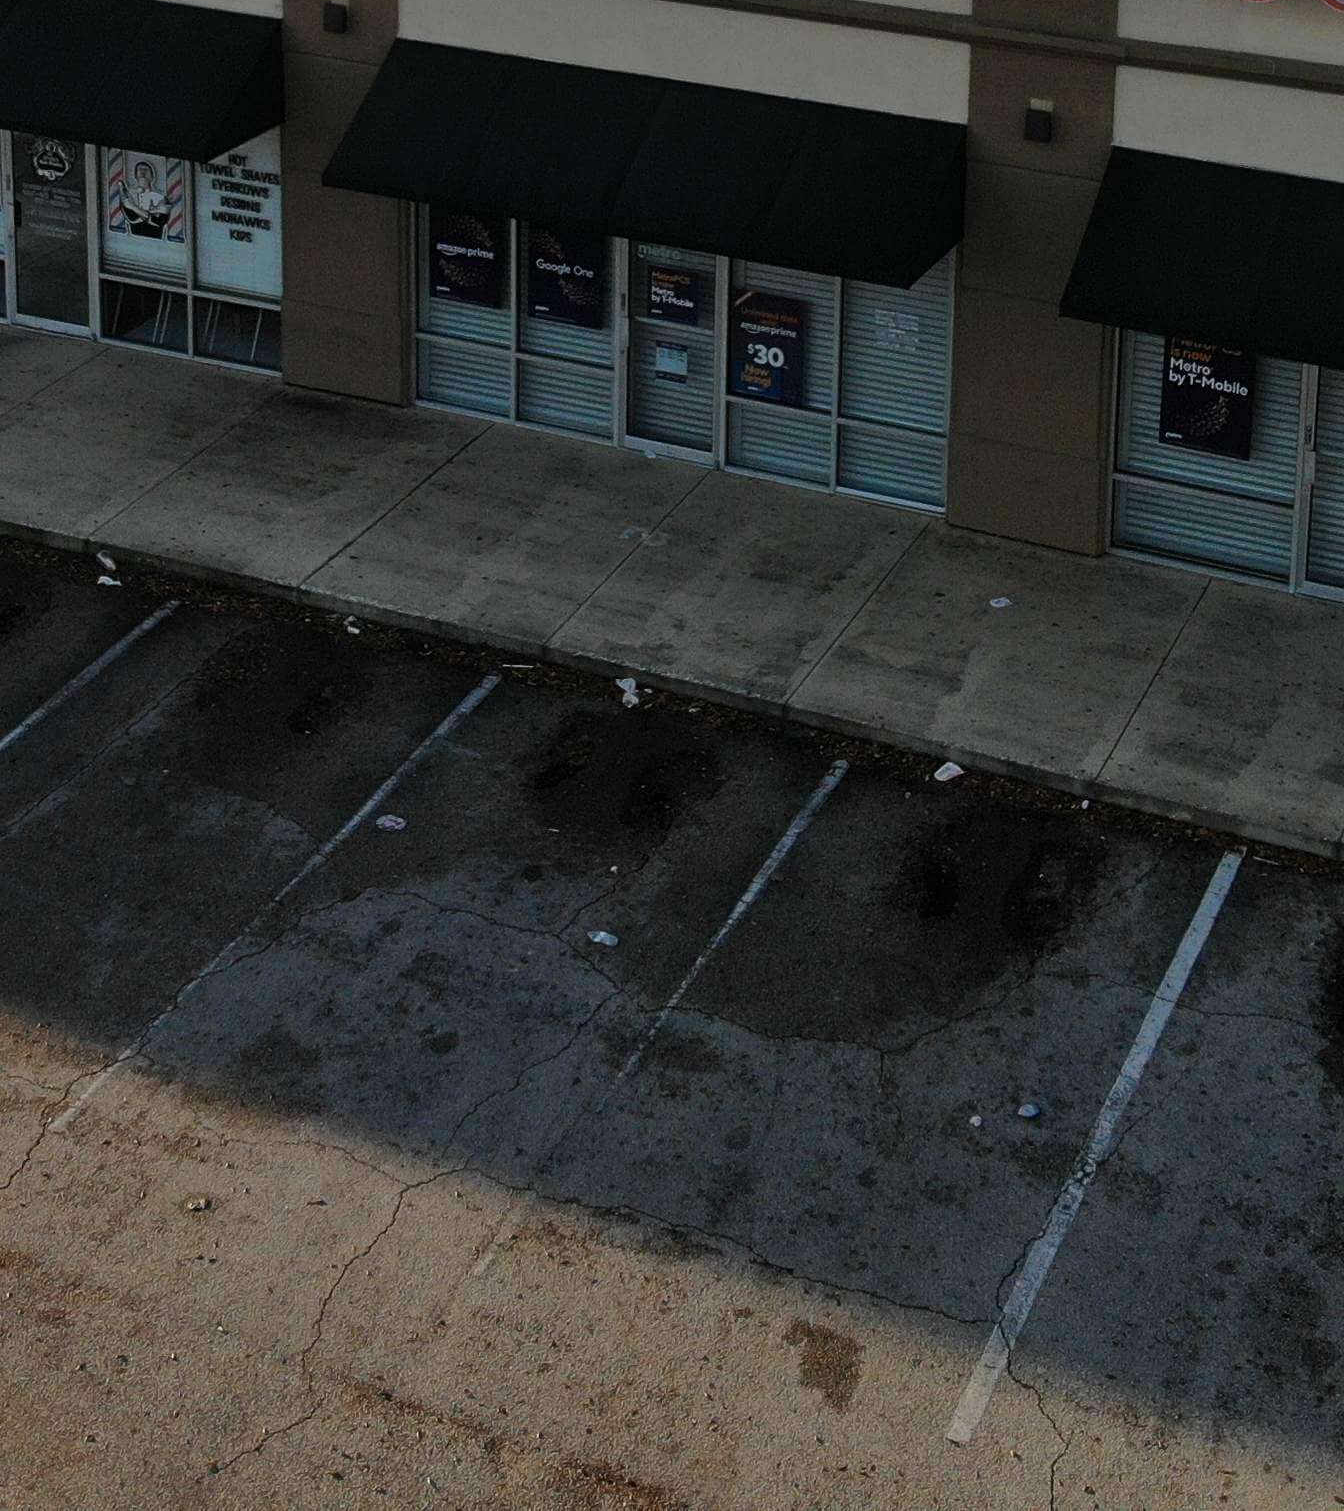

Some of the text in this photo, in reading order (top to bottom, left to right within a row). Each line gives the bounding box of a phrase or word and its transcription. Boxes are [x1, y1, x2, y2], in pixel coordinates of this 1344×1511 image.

[535, 257, 595, 279] Google One
[747, 343, 785, 368] $30
[1170, 356, 1211, 376] Metro
[1183, 349, 1213, 362] now
[1169, 369, 1249, 397] by T-Mobile
